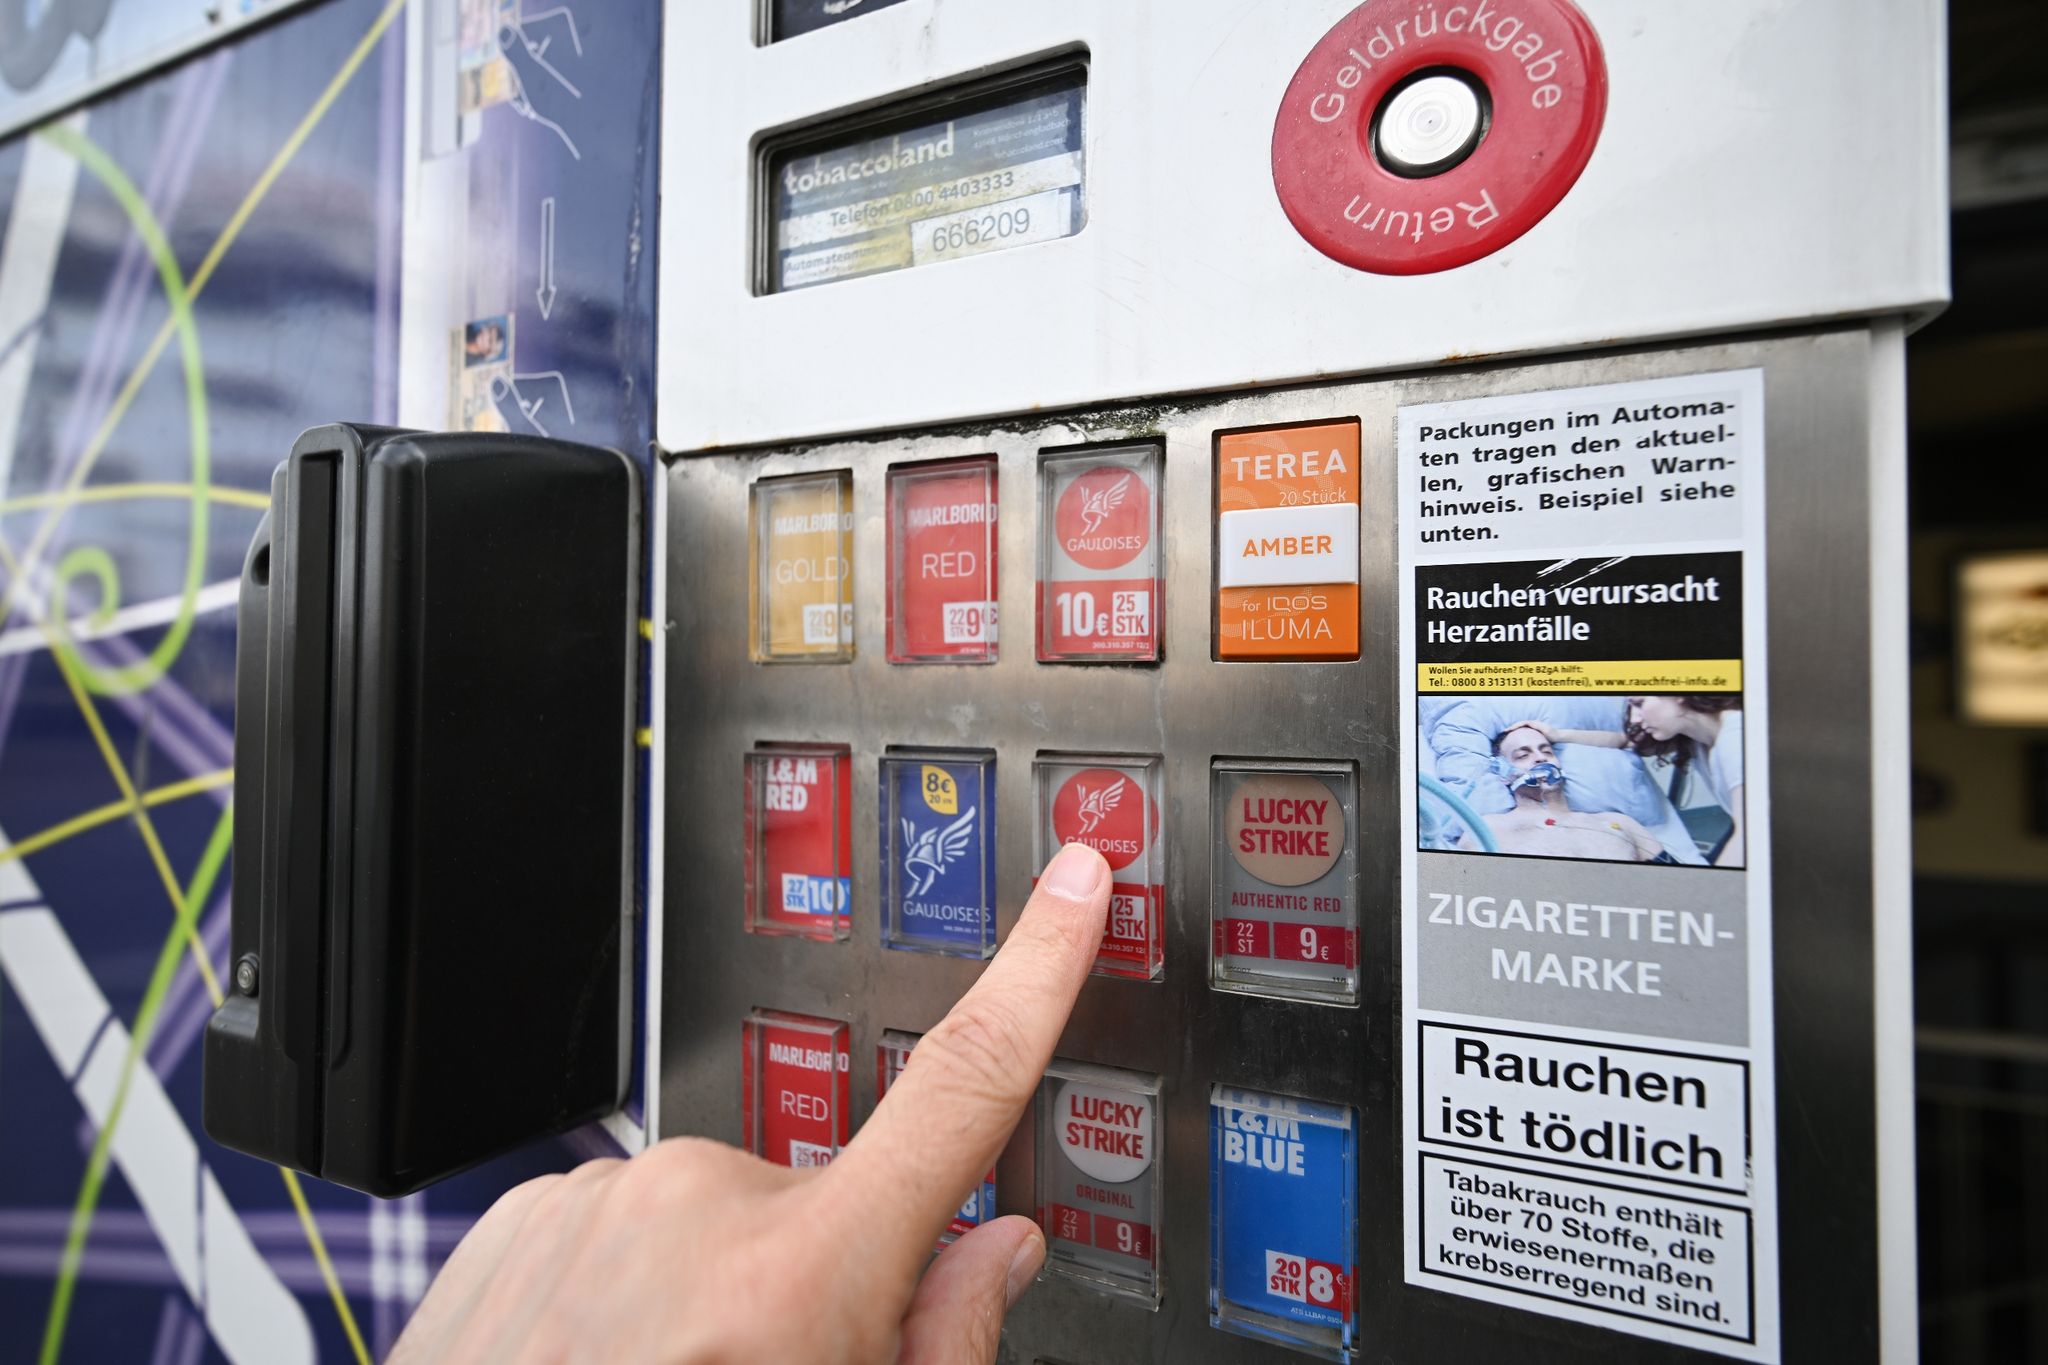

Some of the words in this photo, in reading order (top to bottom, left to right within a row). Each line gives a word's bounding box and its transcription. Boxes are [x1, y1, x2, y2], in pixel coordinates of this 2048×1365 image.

[1310, 0, 1563, 123] Geldrückgabe
[784, 120, 954, 196] tobaccoland
[831, 203, 889, 228] Telefon
[938, 171, 1015, 202] 4403333
[1343, 188, 1499, 243] Return
[932, 208, 1030, 252] 666209
[1419, 415, 1555, 443] Packungen
[1566, 411, 1599, 429] im
[1612, 400, 1735, 424] Automa-
[1420, 449, 1460, 467] ten
[1472, 442, 1556, 465] tragen
[1571, 436, 1620, 455] den
[1636, 424, 1735, 449] aktuel-
[1231, 448, 1347, 481] TEREA
[1420, 475, 1463, 493] len,
[1488, 463, 1625, 492] grafischen
[1652, 457, 1735, 476] Warn-
[1279, 491, 1297, 507] 20
[1302, 487, 1346, 505] Stück
[1420, 497, 1523, 518] hinweis.
[1539, 486, 1643, 511] Beispiel
[1660, 481, 1735, 502] siehe
[1067, 536, 1141, 552] GAULOISES
[1242, 535, 1333, 558] AMBER
[1420, 524, 1499, 543] unten.
[776, 556, 849, 584] GOLD
[922, 551, 976, 579] RED
[1115, 594, 1135, 612] 25
[1242, 599, 1261, 612] for
[1267, 595, 1328, 612] IQOS
[1427, 583, 1546, 610] Rauchen
[1555, 575, 1719, 607] verursacht
[950, 608, 965, 625] 22
[1115, 615, 1145, 633] STK
[1242, 616, 1333, 641] ILUMA
[1427, 616, 1590, 643] Herzanfälle
[1428, 666, 1458, 675] Wollen
[1459, 666, 1472, 675] Sie
[1473, 665, 1517, 675] aufhören?
[1519, 665, 1534, 674] Die
[1536, 665, 1559, 676] BZgA
[1429, 678, 1450, 687] Tel.:
[1451, 678, 1477, 687] 0800
[1479, 678, 1486, 687] 8
[1487, 678, 1524, 687] 313131
[1526, 676, 1592, 688] (kostenfrei),
[766, 758, 817, 784] L&M
[766, 785, 808, 811] RED
[1243, 798, 1328, 825] LUCKY
[1239, 828, 1330, 857] STRIKE
[903, 901, 991, 923] GAULOISES
[1115, 897, 1133, 915] 25
[1232, 892, 1307, 911] AUTHENTIC
[1313, 897, 1341, 912] RED
[1115, 919, 1144, 937] STK
[1237, 922, 1254, 938] 22
[1428, 893, 1735, 947] ZIGARETTEN-
[1238, 939, 1254, 954] ST
[1491, 948, 1662, 996] MARKE
[769, 1043, 849, 1073] MARLBORO
[1455, 1037, 1707, 1108] Rauchen
[780, 1090, 828, 1122] RED
[1071, 1094, 1144, 1128] LUCKY
[1223, 1104, 1301, 1140] L&M
[1066, 1122, 1144, 1159] STRIKE
[1442, 1097, 1504, 1143] ist
[1522, 1109, 1723, 1178] tödlich
[1224, 1130, 1305, 1177] BLUE
[1076, 1183, 1135, 1209] ORIGINAL
[1443, 1169, 1606, 1217] Tabakrauch
[1616, 1204, 1724, 1239] enthält
[1062, 1209, 1078, 1224] 22
[1062, 1225, 1078, 1240] ST
[1451, 1198, 1512, 1227] über
[1521, 1210, 1553, 1233] 70
[1562, 1217, 1658, 1257] Stoffe,
[1669, 1236, 1715, 1264] die
[1274, 1257, 1302, 1277] 20
[1452, 1224, 1713, 1292] erwiesenermaßen
[1270, 1276, 1301, 1296] STK
[1439, 1244, 1646, 1306] krebserregend
[1657, 1292, 1731, 1325] sind.
